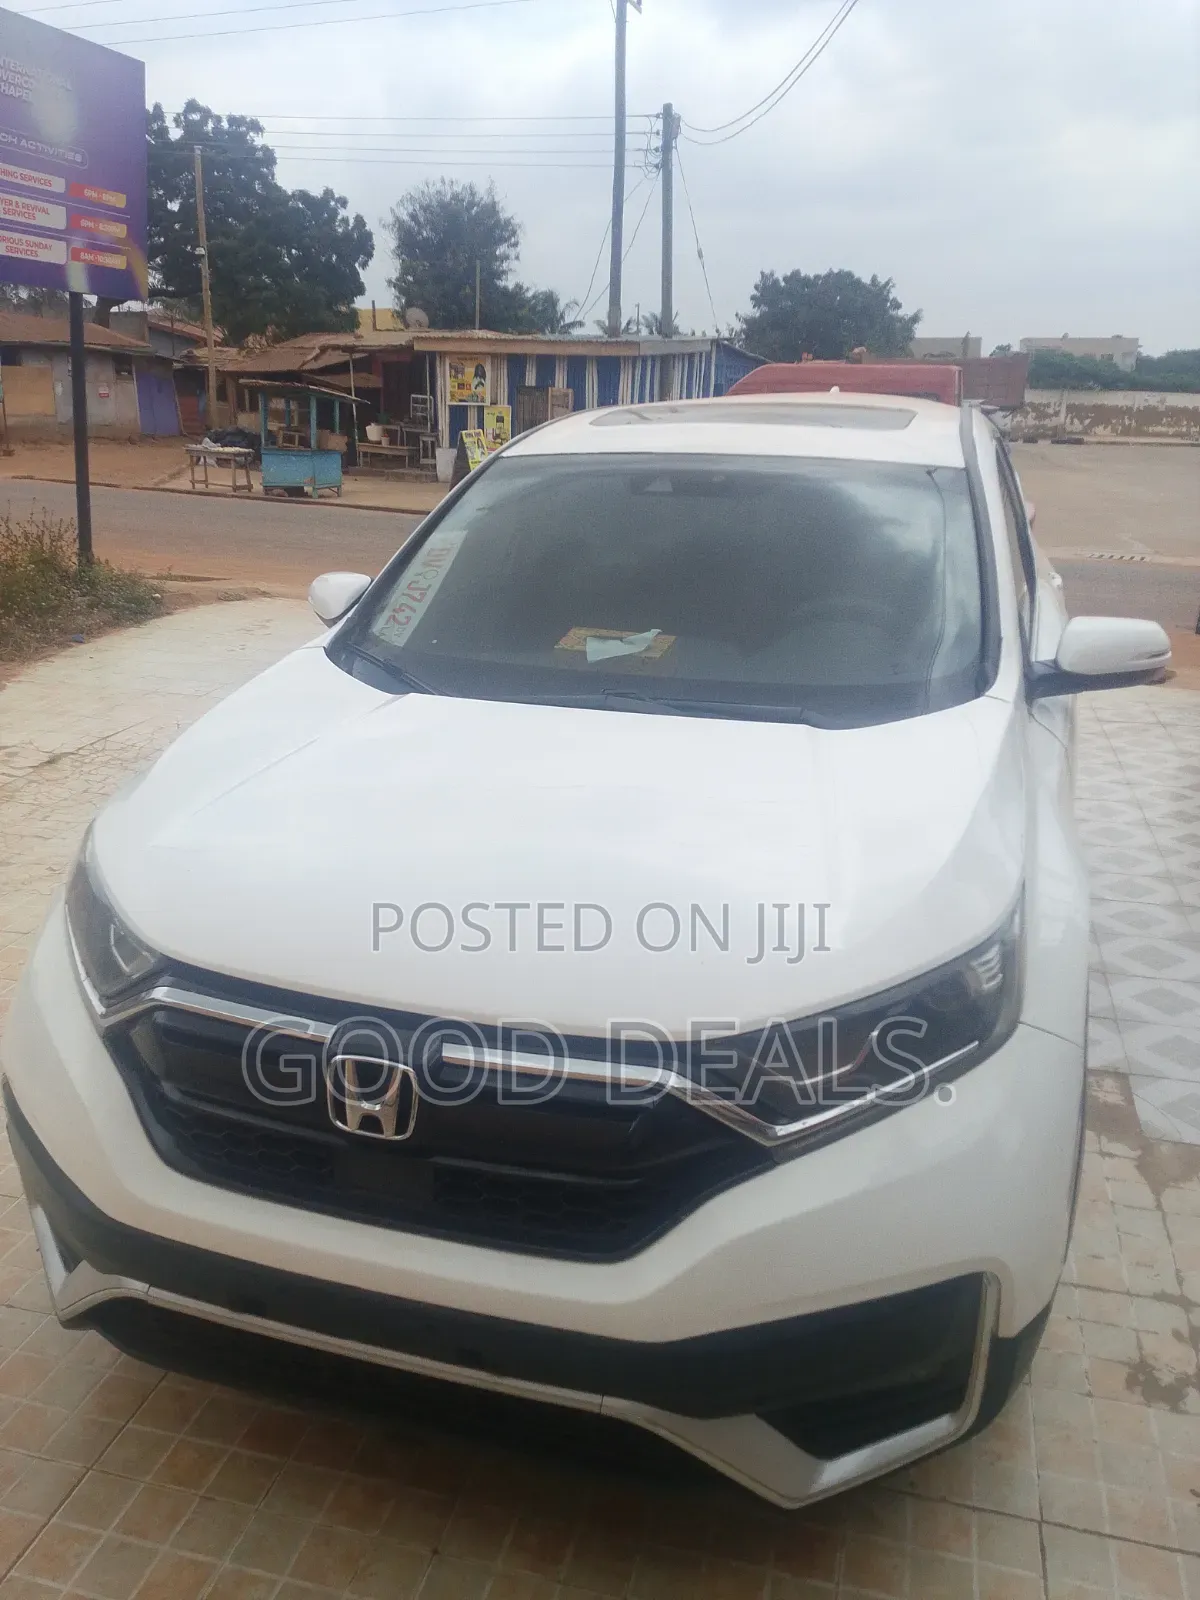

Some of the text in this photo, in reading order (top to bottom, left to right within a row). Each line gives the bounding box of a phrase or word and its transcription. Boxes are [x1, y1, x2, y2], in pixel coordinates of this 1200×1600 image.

[19, 172, 53, 188] SERVICES
[2, 207, 37, 221] SERVICES
[21, 202, 51, 215] REVIVAL
[5, 245, 39, 258] SERVICES
[25, 240, 53, 251] SUNDAY
